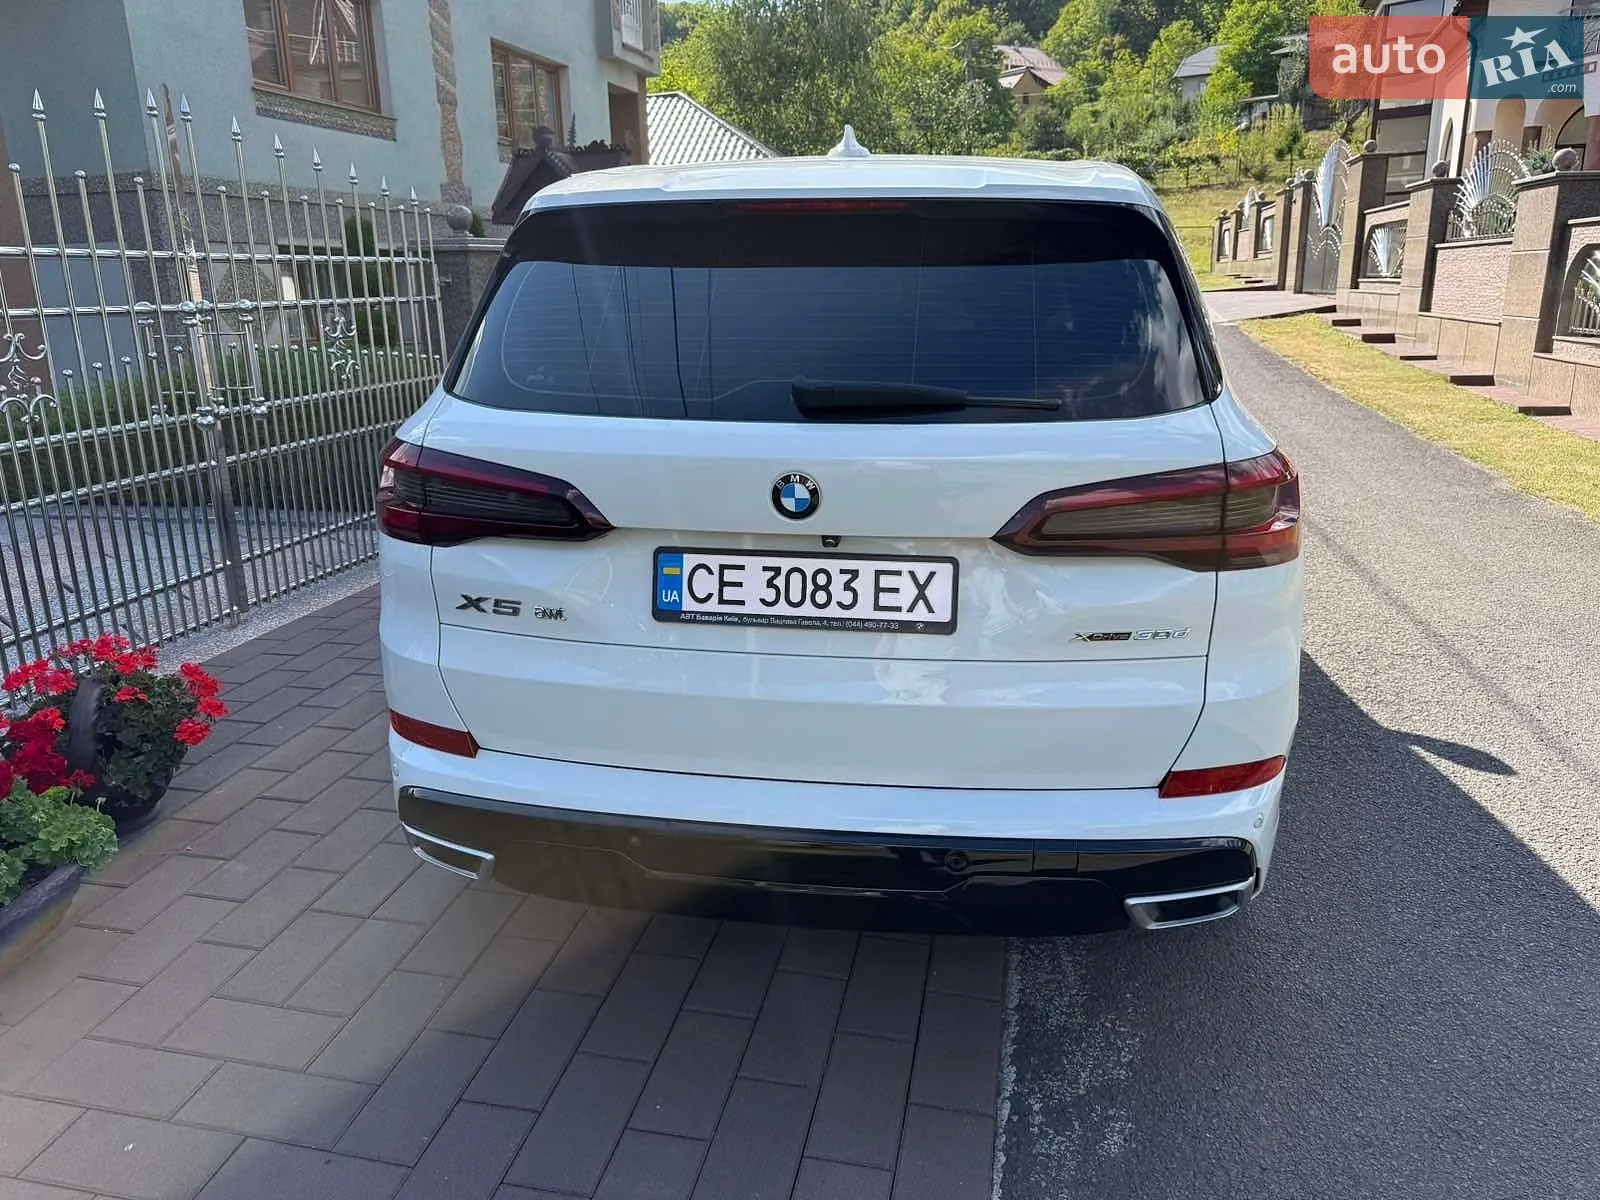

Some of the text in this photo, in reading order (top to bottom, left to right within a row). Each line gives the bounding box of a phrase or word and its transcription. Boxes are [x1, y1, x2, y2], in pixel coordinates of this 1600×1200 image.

[776, 474, 816, 490] BMW
[662, 589, 680, 603] UA
[687, 562, 937, 613] CE 3083 EX
[455, 592, 522, 617] X5
